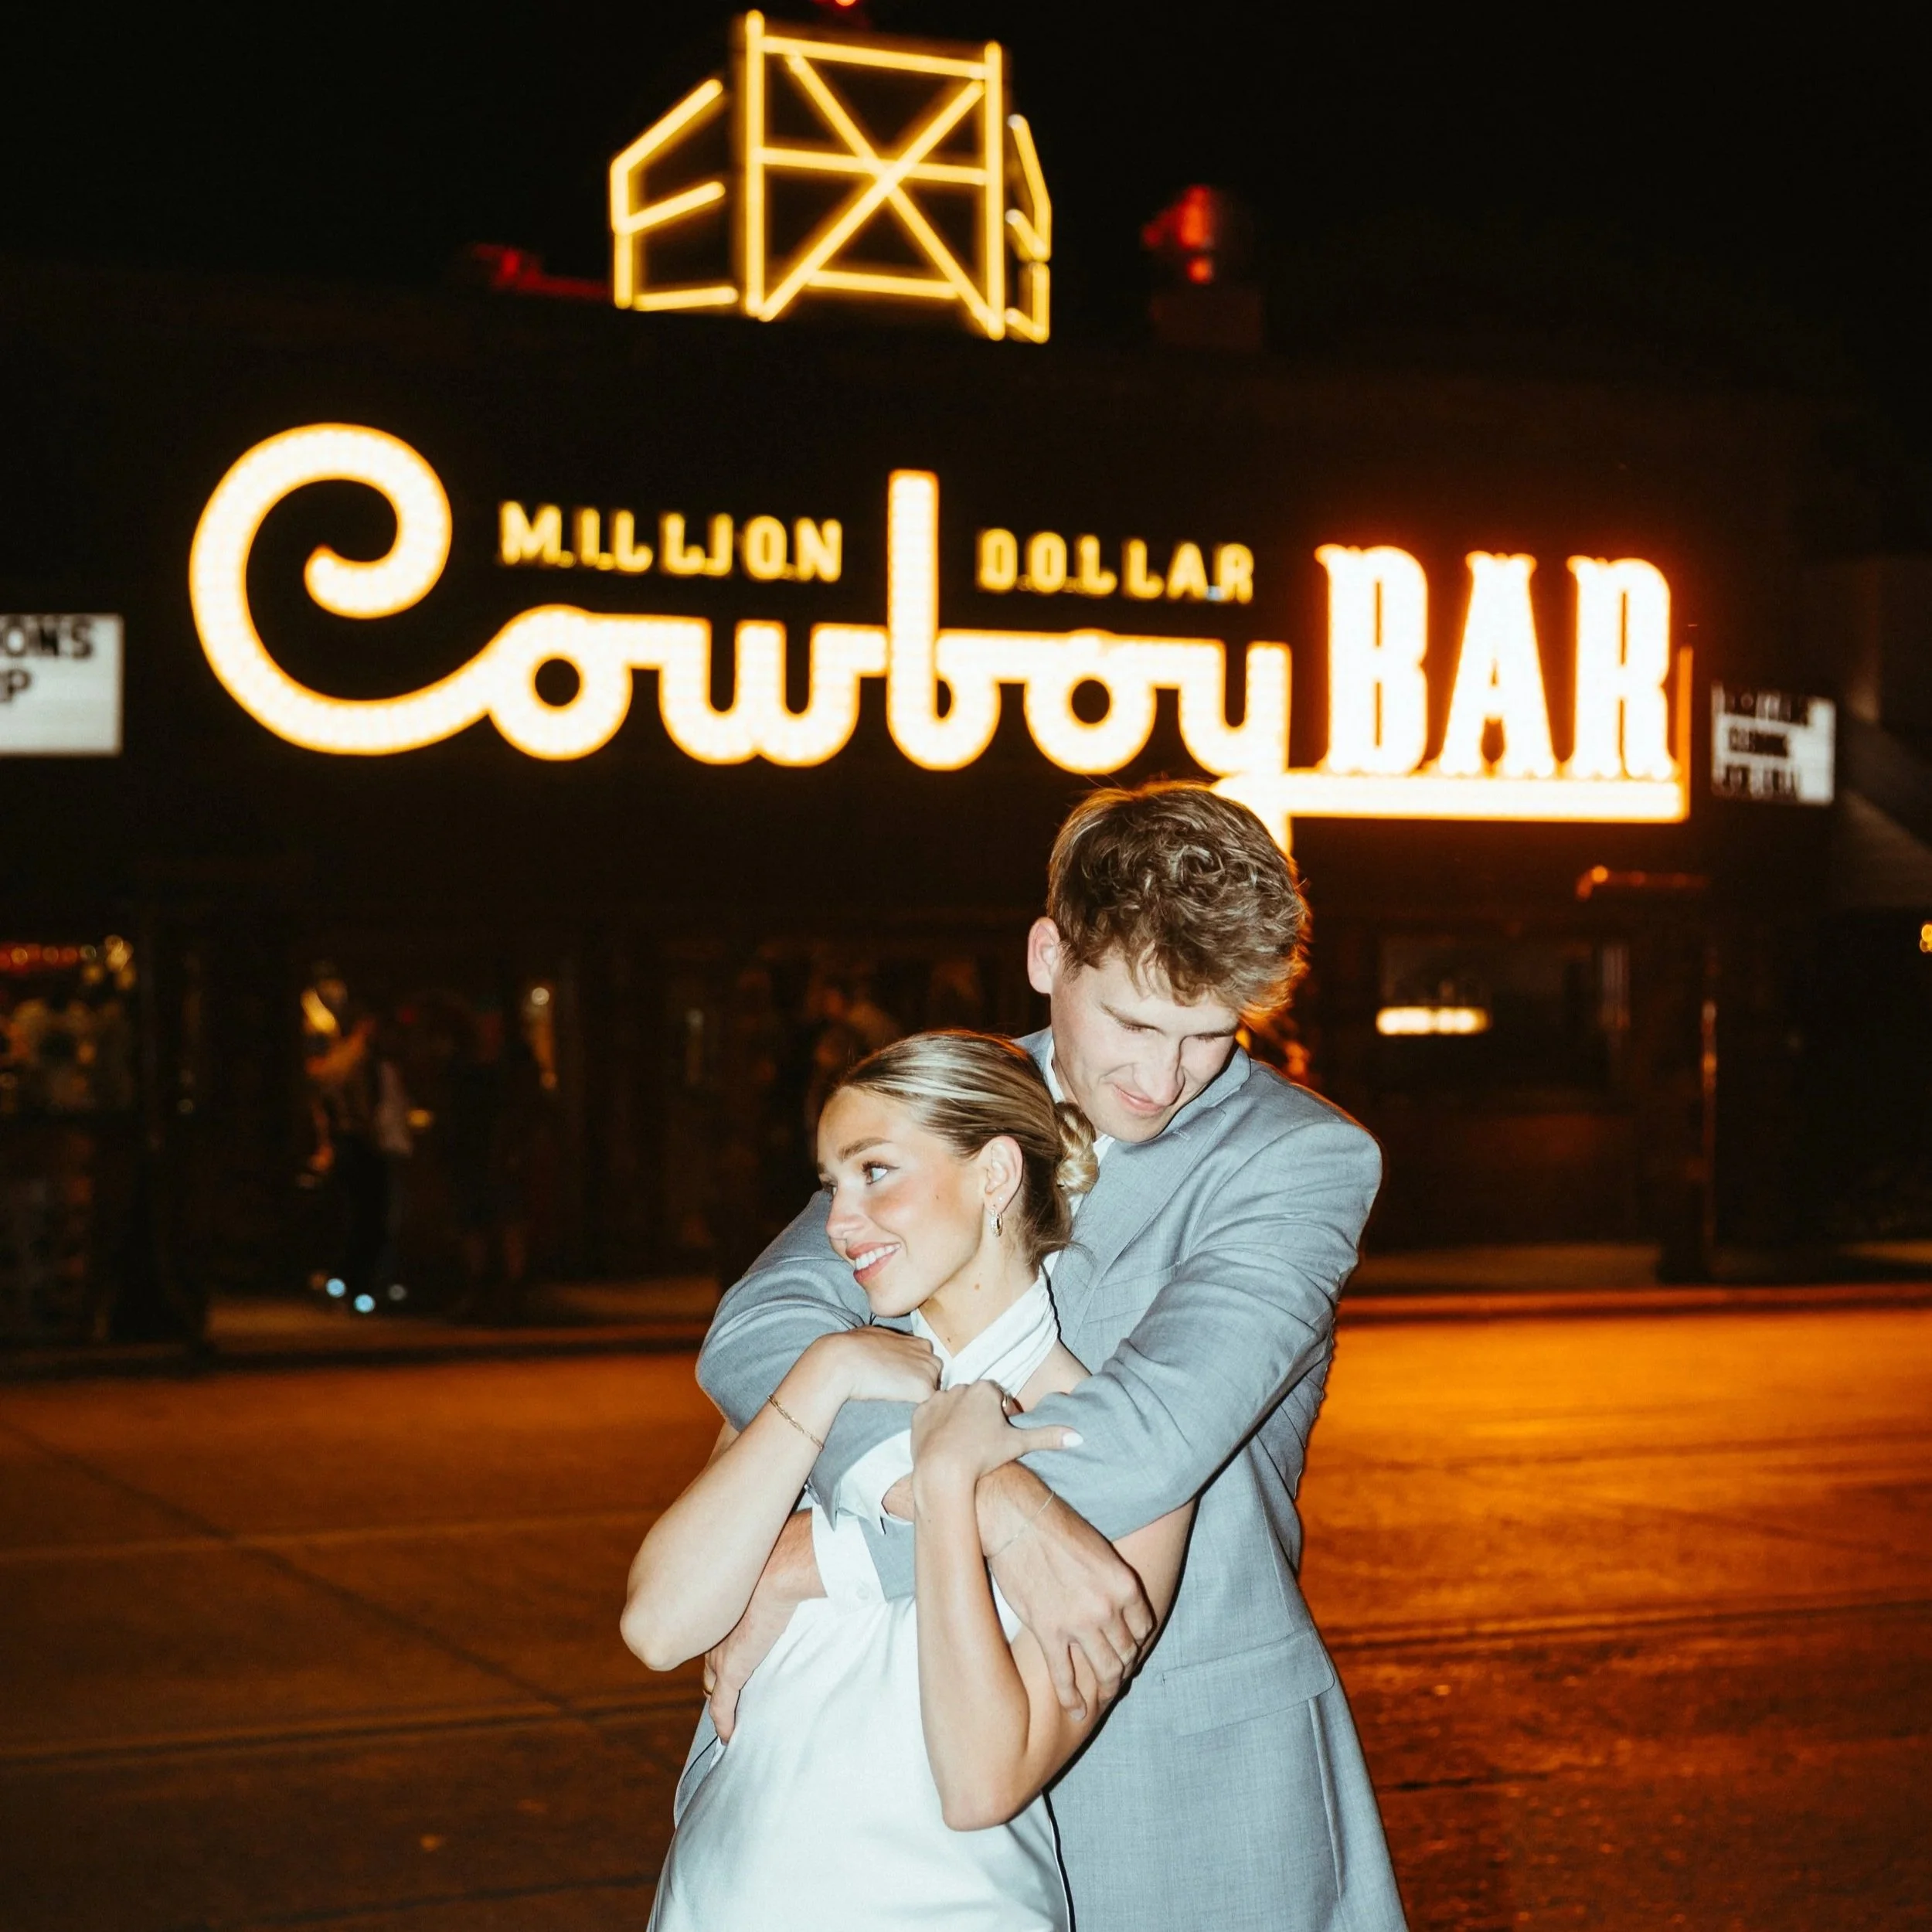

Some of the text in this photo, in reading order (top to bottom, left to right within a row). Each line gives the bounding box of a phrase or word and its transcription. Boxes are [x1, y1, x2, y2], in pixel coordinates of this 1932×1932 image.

[189, 422, 1679, 854] Cowboy BAR
[499, 501, 1255, 604] MILLION DOLLAR
